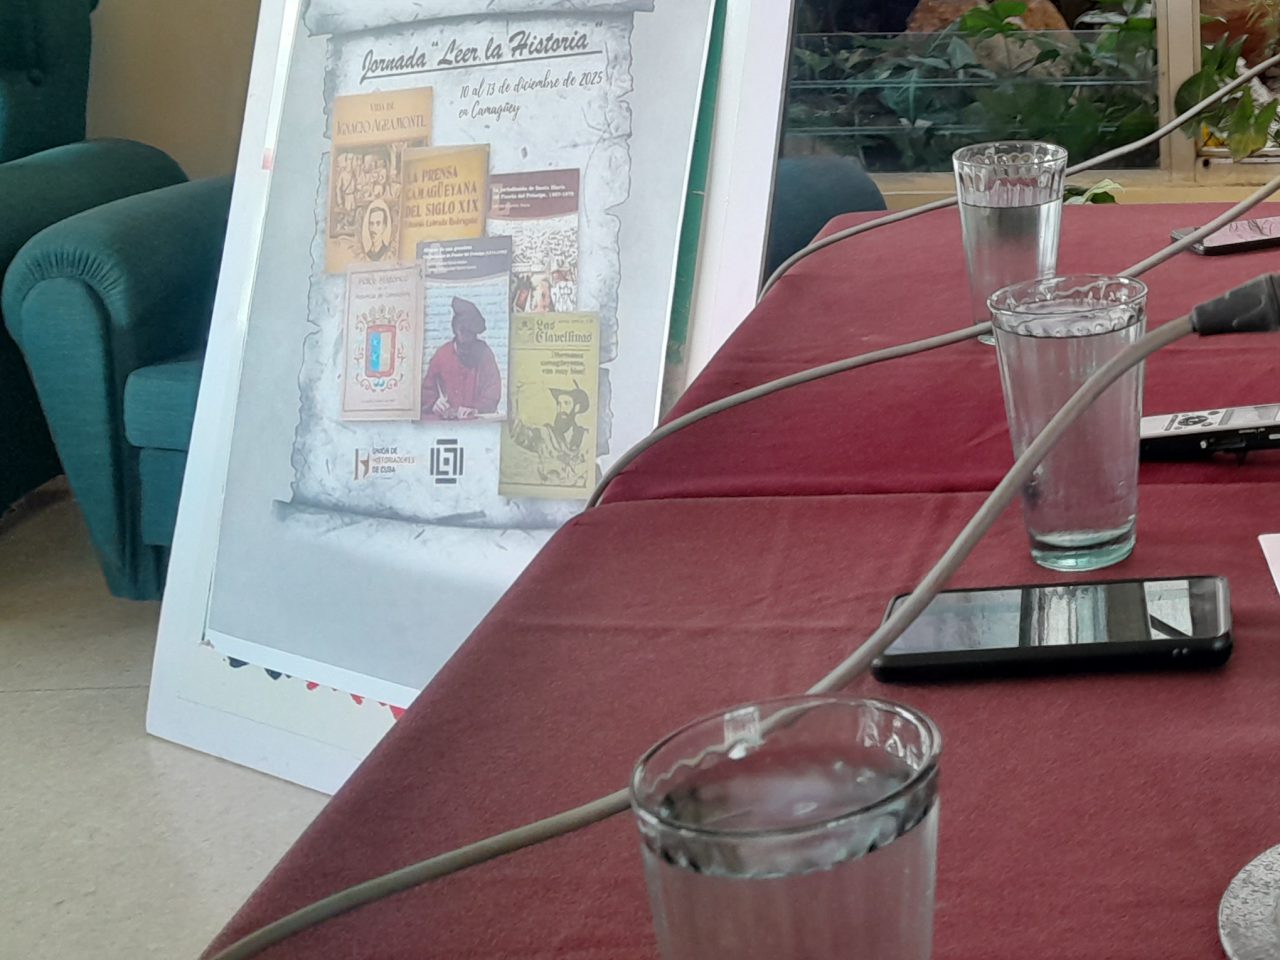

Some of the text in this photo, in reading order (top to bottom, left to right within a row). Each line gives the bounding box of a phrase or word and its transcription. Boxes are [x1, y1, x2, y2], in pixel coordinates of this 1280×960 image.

[361, 47, 427, 80] Jornada
[485, 40, 503, 60] la
[460, 85, 470, 99] 10
[472, 79, 485, 97] al
[498, 78, 510, 95] de
[513, 69, 560, 93] diciembre
[563, 70, 576, 88] de
[579, 70, 603, 88] 2025
[459, 100, 521, 122] en Camagüey
[421, 165, 458, 183] PRENSA
[405, 181, 478, 202] CAMAGÜEYANA
[405, 198, 480, 219] DEL SIGLO XIX
